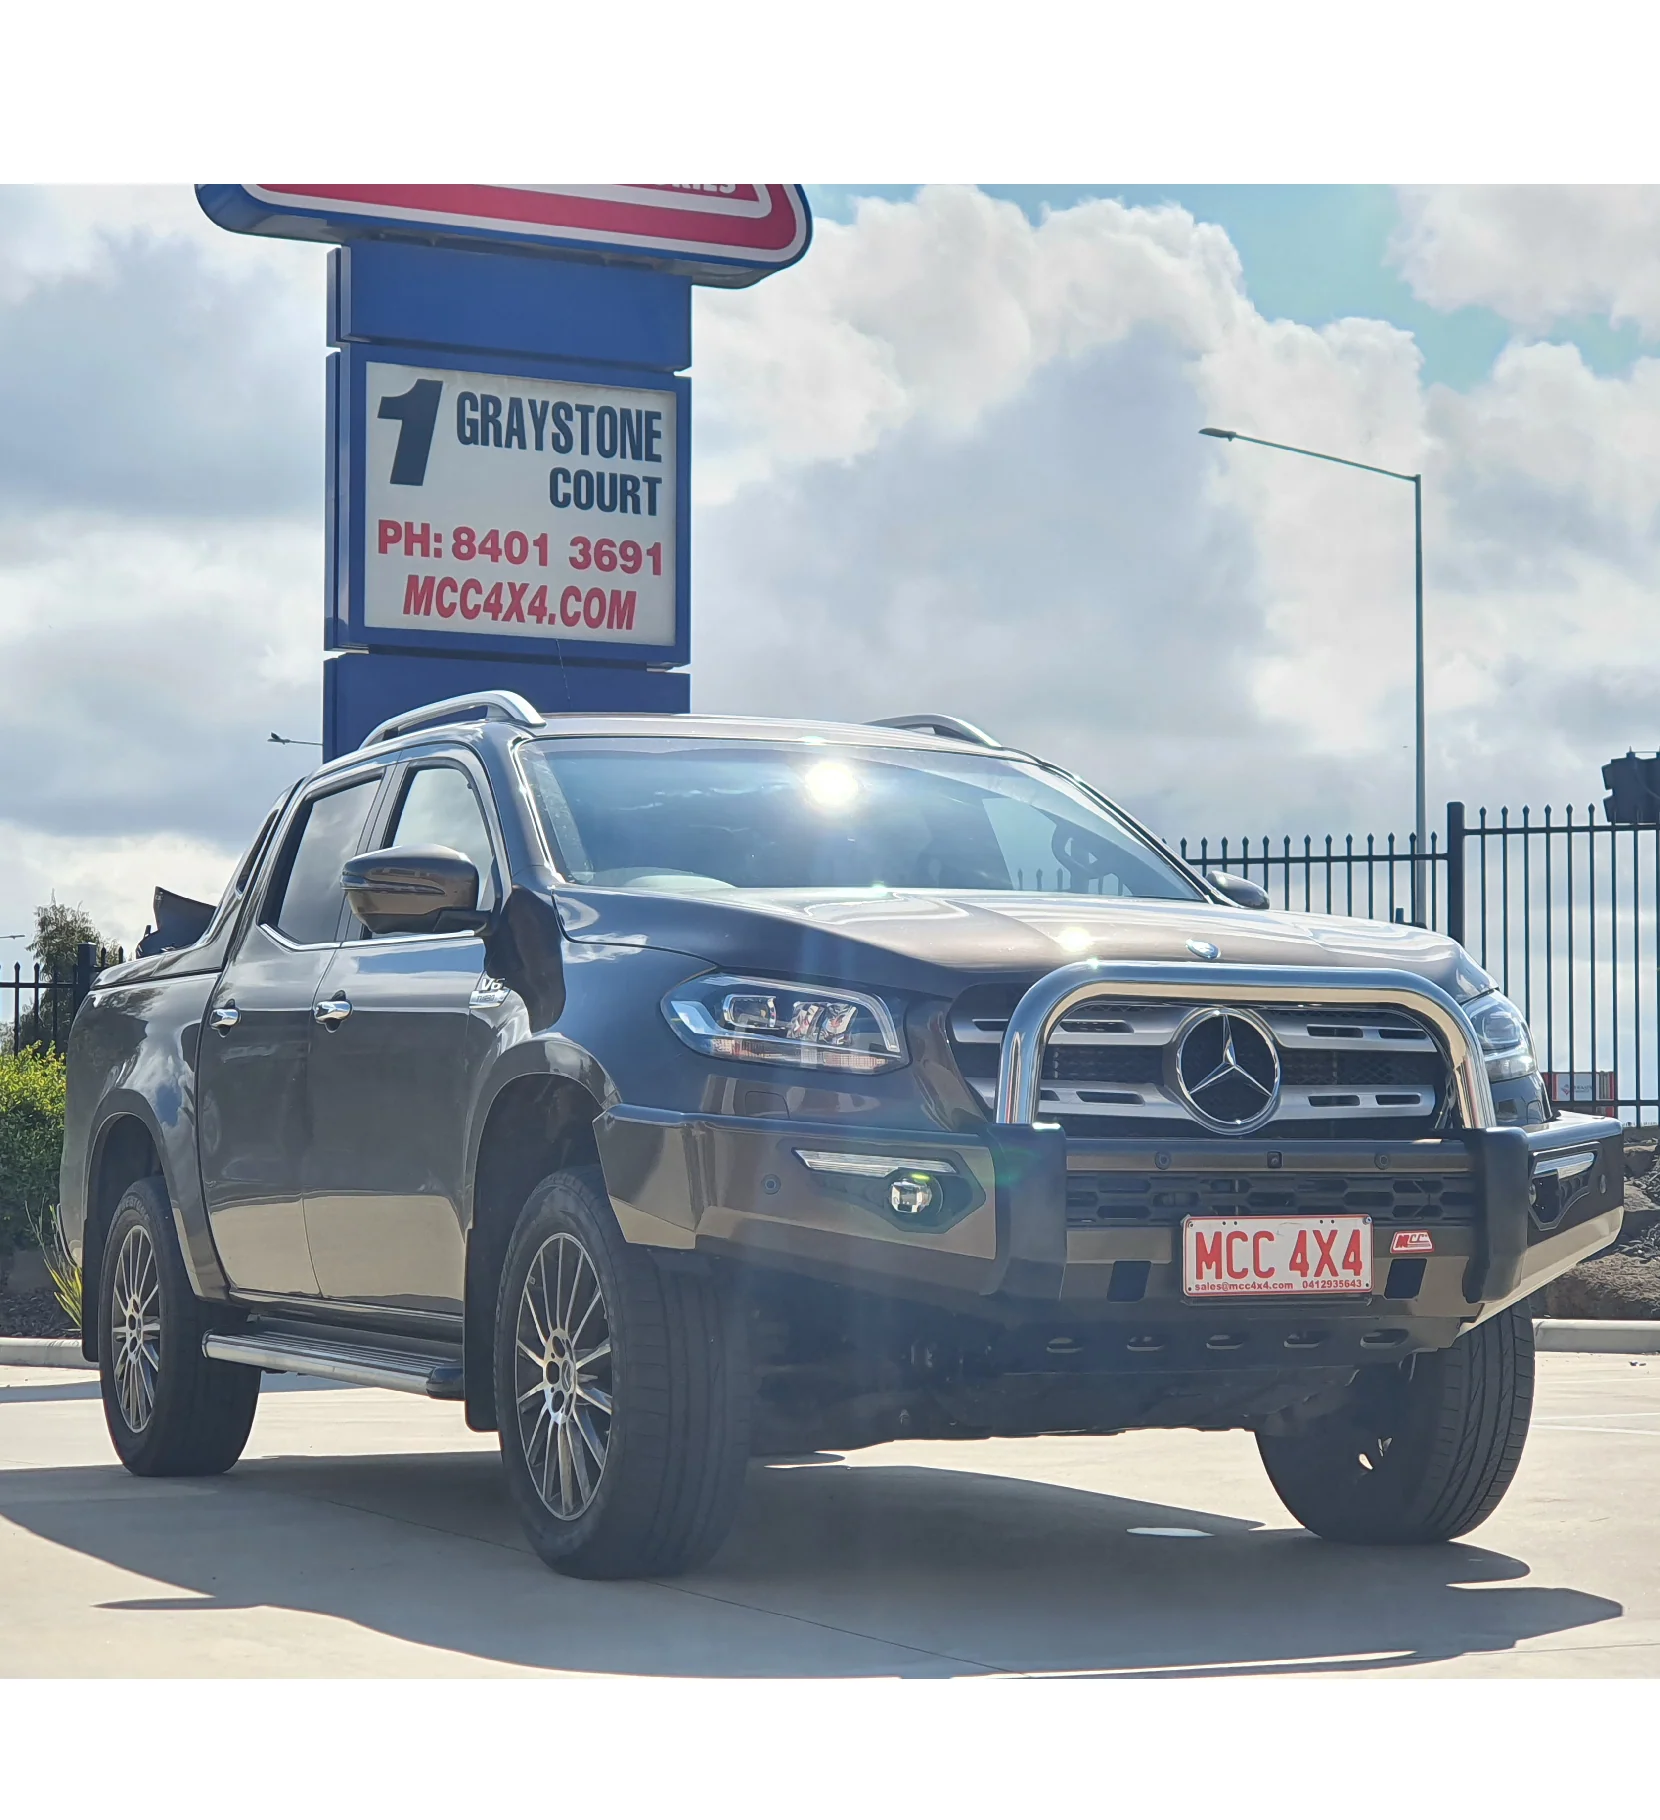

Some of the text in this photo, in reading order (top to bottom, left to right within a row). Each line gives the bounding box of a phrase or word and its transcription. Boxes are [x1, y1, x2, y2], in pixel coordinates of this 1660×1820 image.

[376, 378, 662, 487] 1 GRAYSTONE
[549, 467, 662, 517] COURT
[377, 519, 663, 576] PH: 8401 3691
[403, 574, 637, 631] MCC4X4.COM
[482, 978, 506, 991] V6
[1195, 1229, 1363, 1280] MCC 4X4
[1194, 1279, 1362, 1291] sales@mcc4x4.com 0412935643
